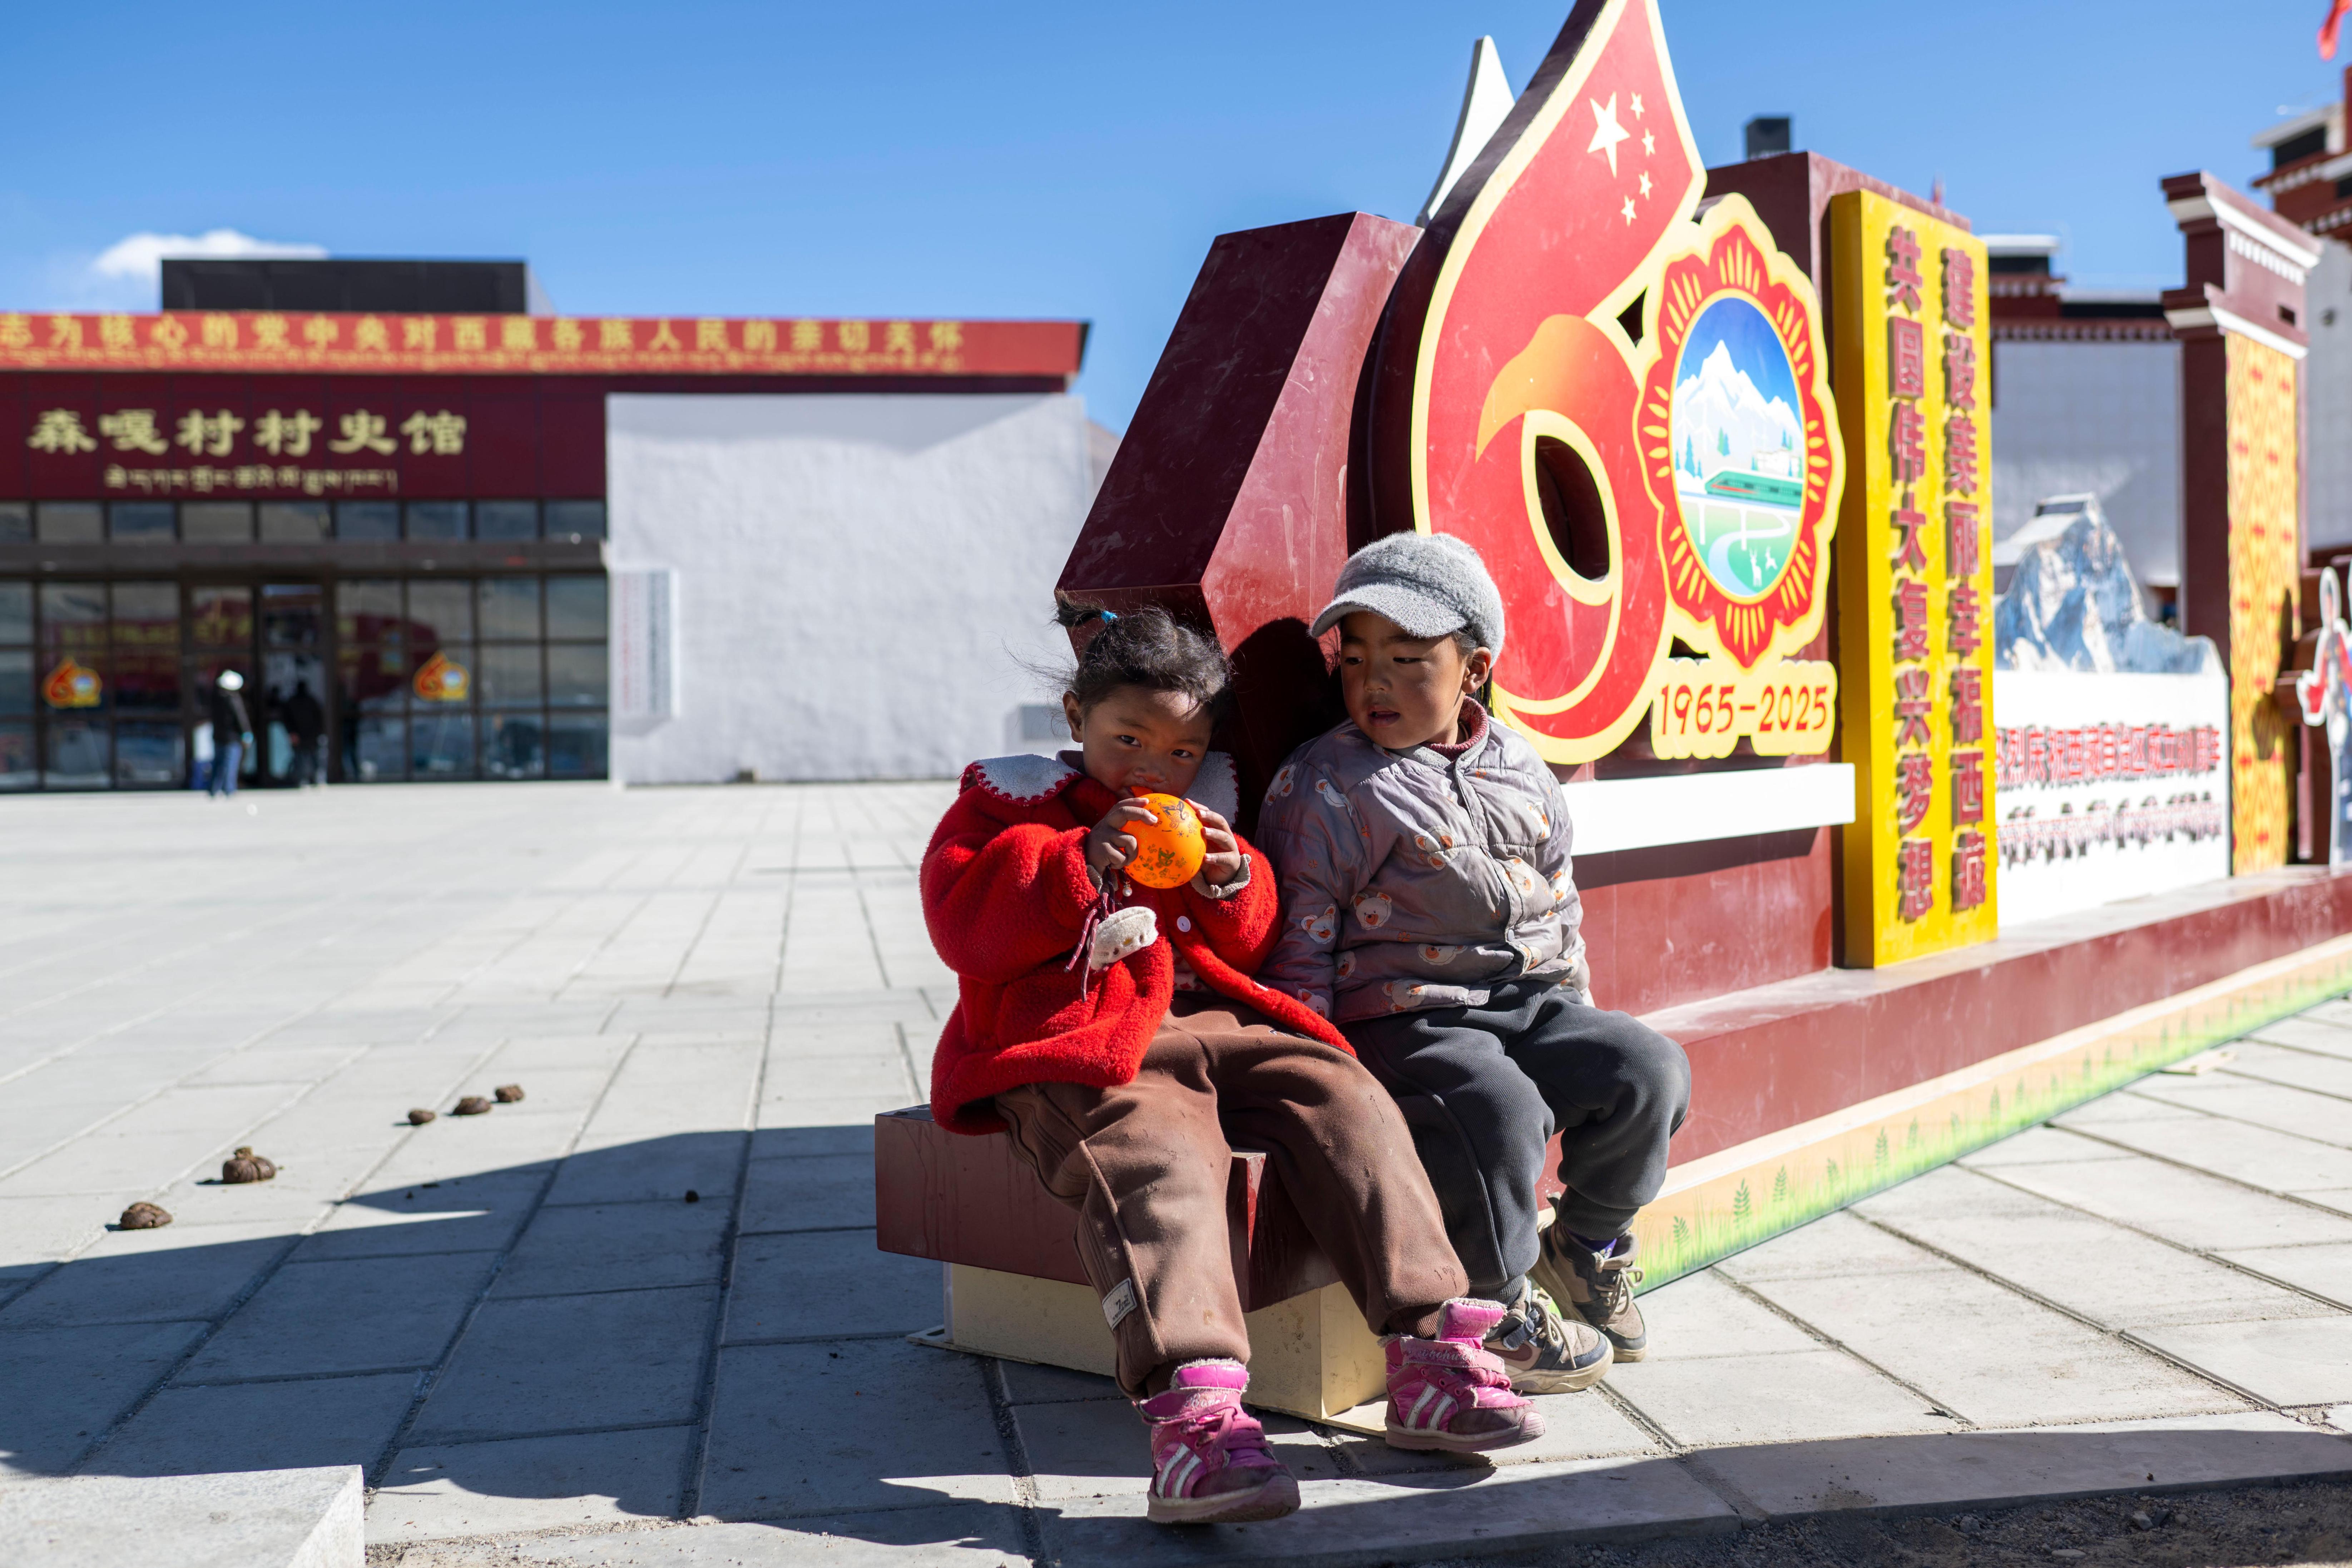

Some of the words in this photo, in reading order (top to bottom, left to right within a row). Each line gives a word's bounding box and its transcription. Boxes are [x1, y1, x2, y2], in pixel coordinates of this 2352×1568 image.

[1661, 683, 1827, 735] 1965-2025
[1884, 225, 1933, 924] 共圆伟大复兴梦想
[1940, 247, 1986, 914] 建设美丽幸福西藏
